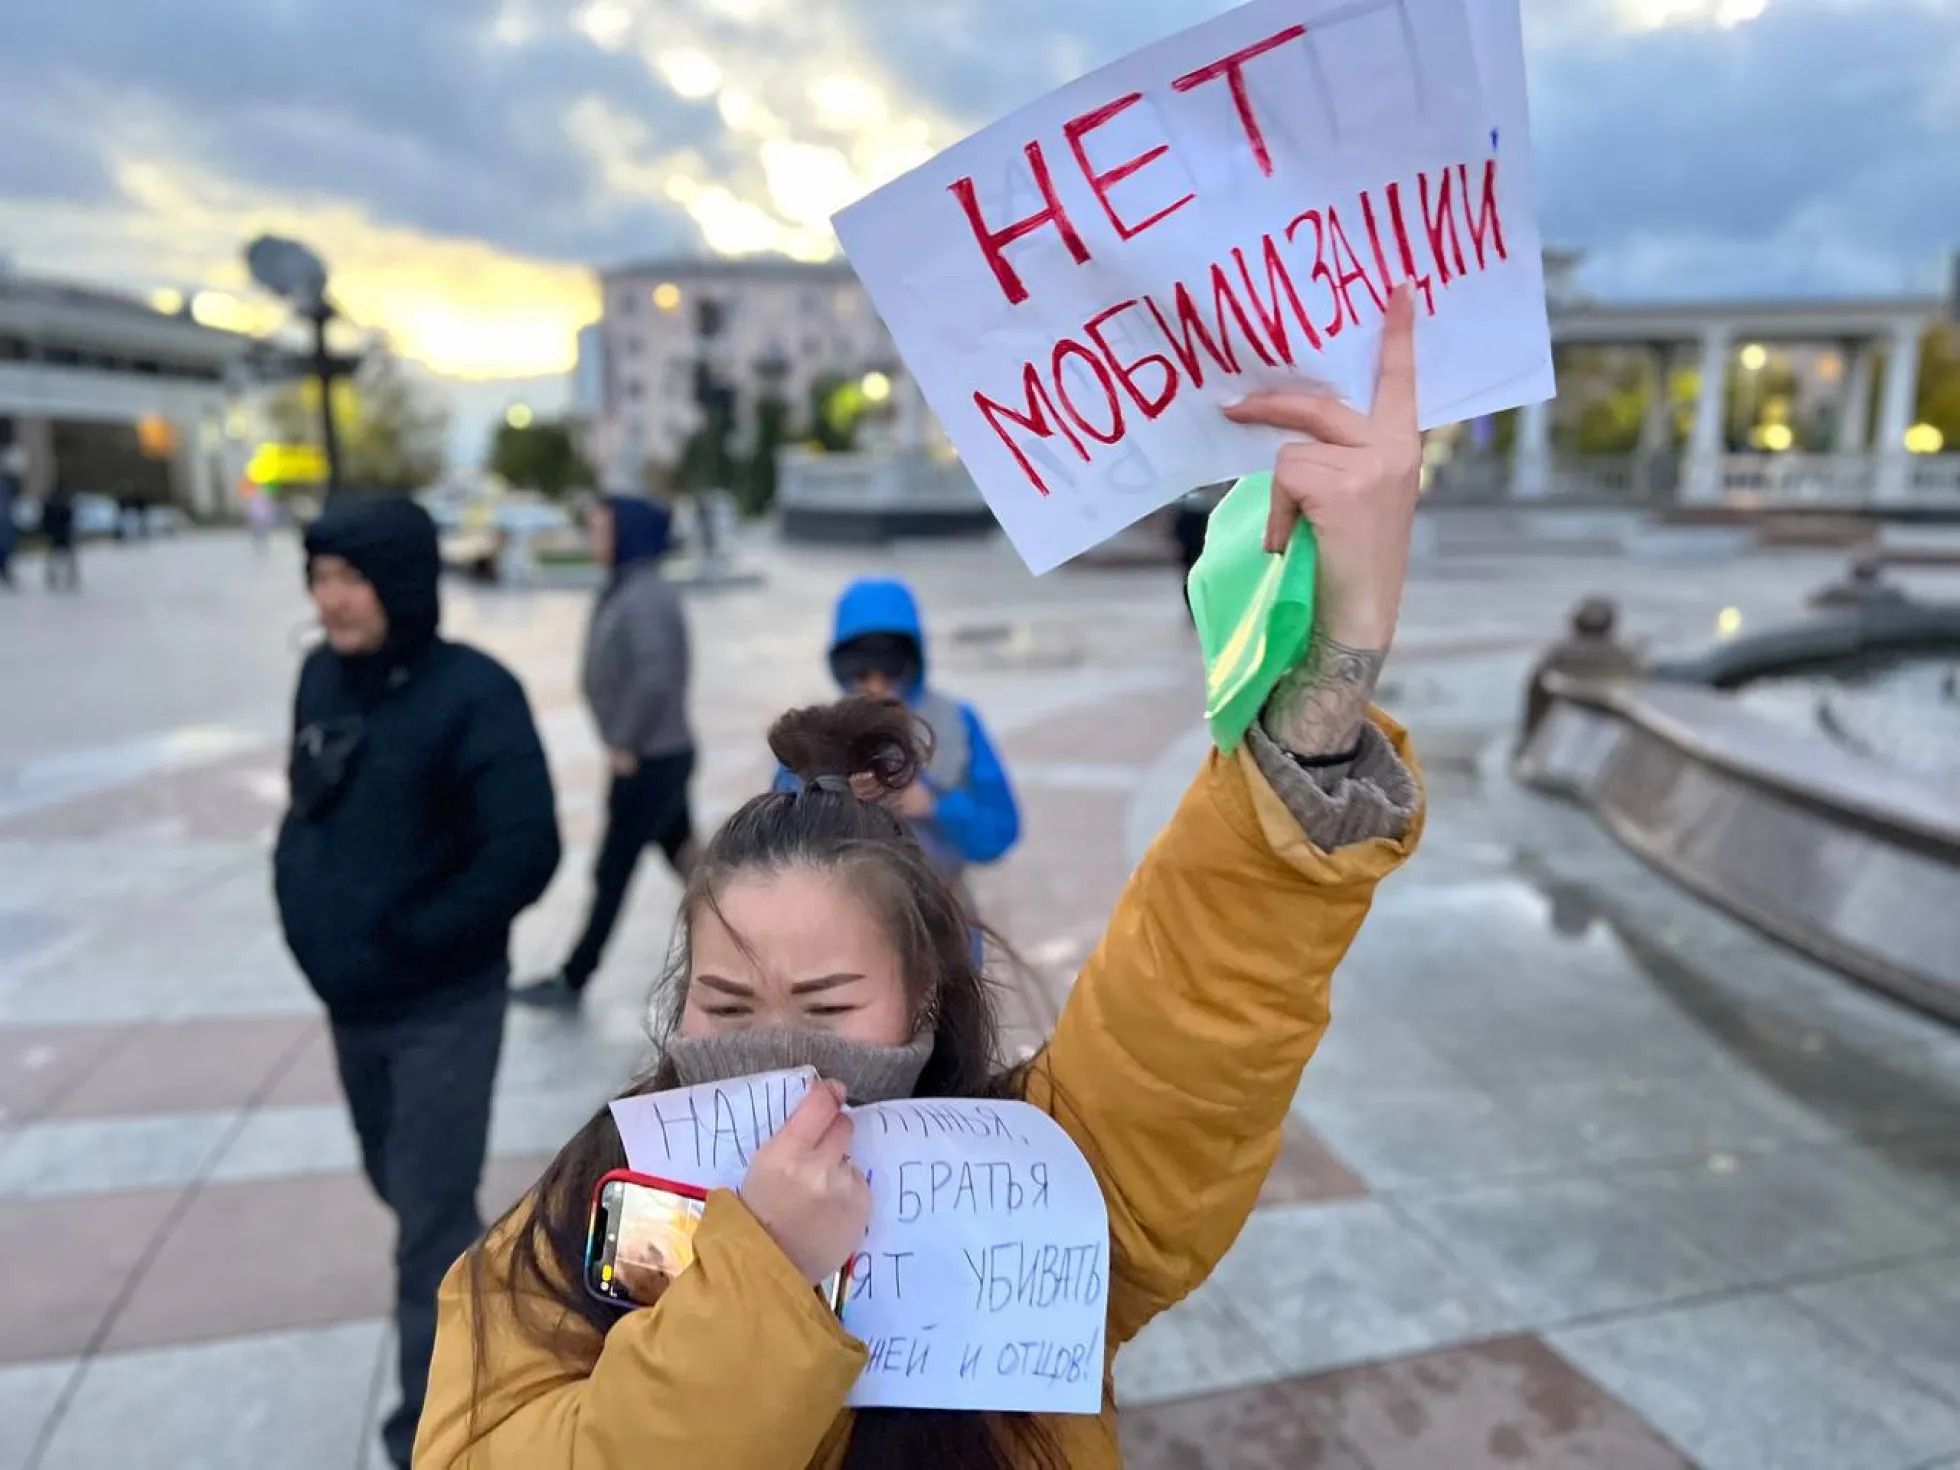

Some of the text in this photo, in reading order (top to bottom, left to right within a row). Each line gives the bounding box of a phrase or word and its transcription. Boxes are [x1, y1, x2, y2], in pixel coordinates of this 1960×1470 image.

[946, 23, 1307, 306] НЕТ
[652, 1075, 808, 1170] НАШ
[897, 1160, 1049, 1225] БРАТЬЯ
[851, 1239, 1101, 1313] ЯТ УБИВАТЬ
[865, 1322, 1100, 1384] ЖЕЙ И ОТЦОВ!
